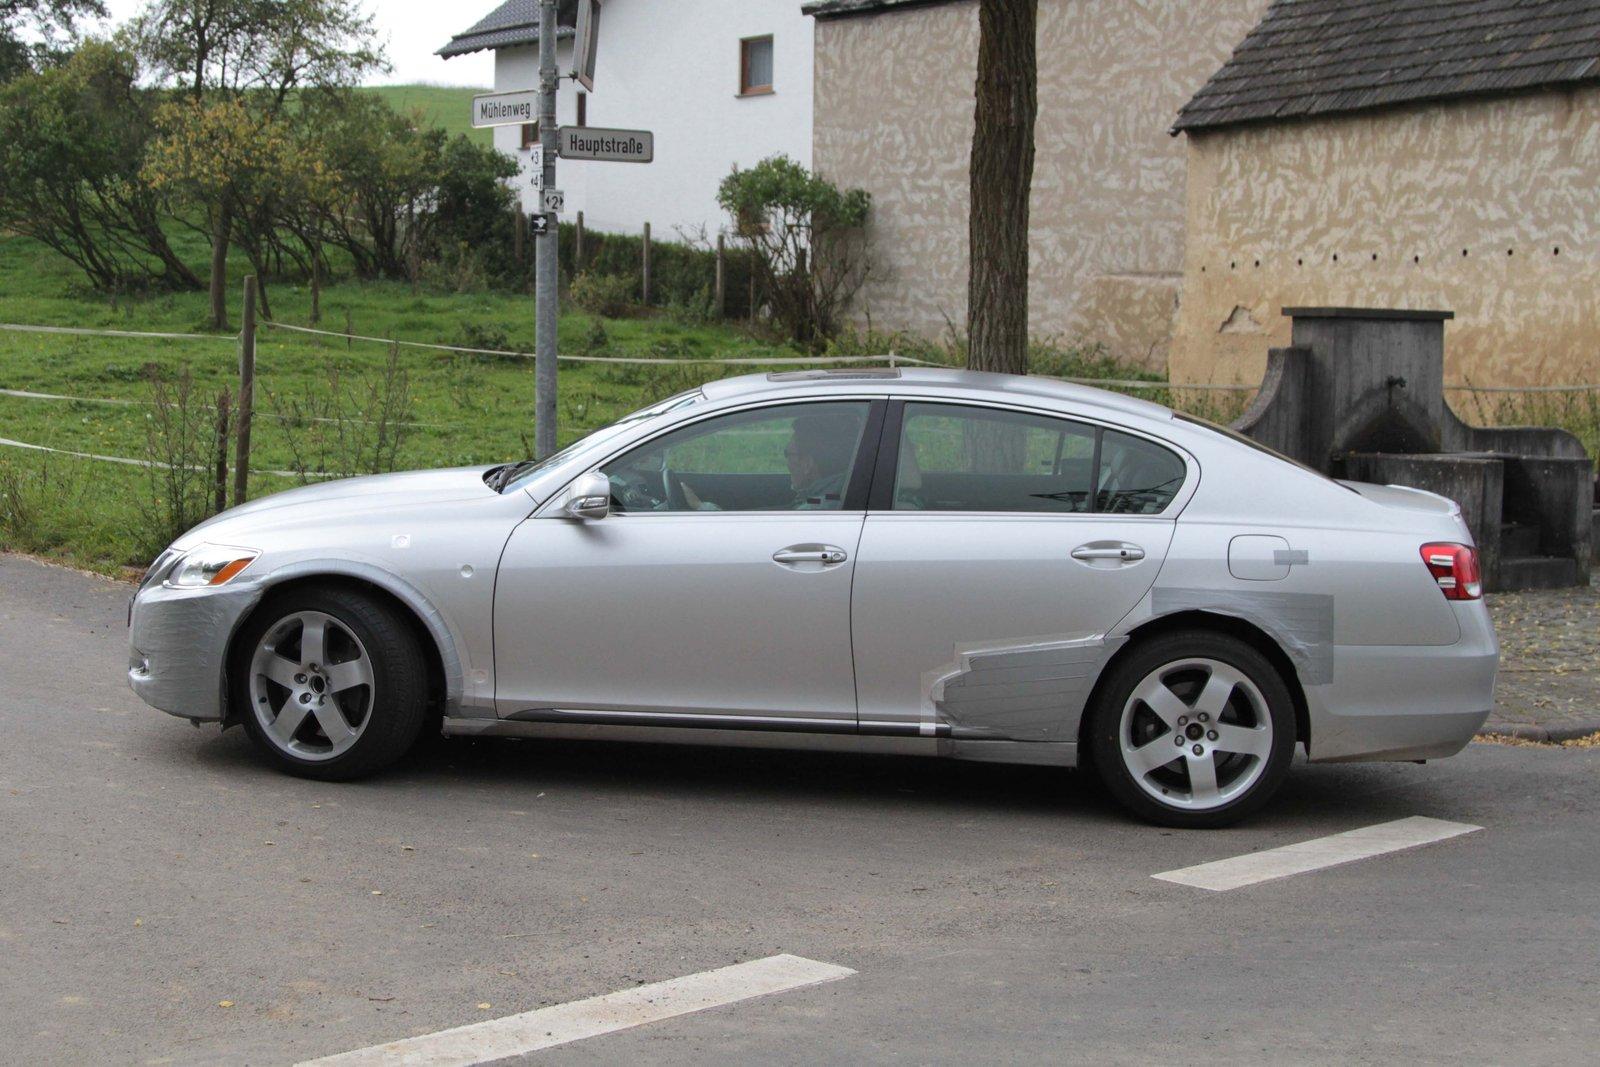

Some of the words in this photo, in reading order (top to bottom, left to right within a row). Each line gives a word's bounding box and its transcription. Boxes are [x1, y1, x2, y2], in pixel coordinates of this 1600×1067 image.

[480, 101, 531, 119] Mühlenweg
[570, 134, 643, 156] Hauptstraße
[551, 195, 559, 210] 2
